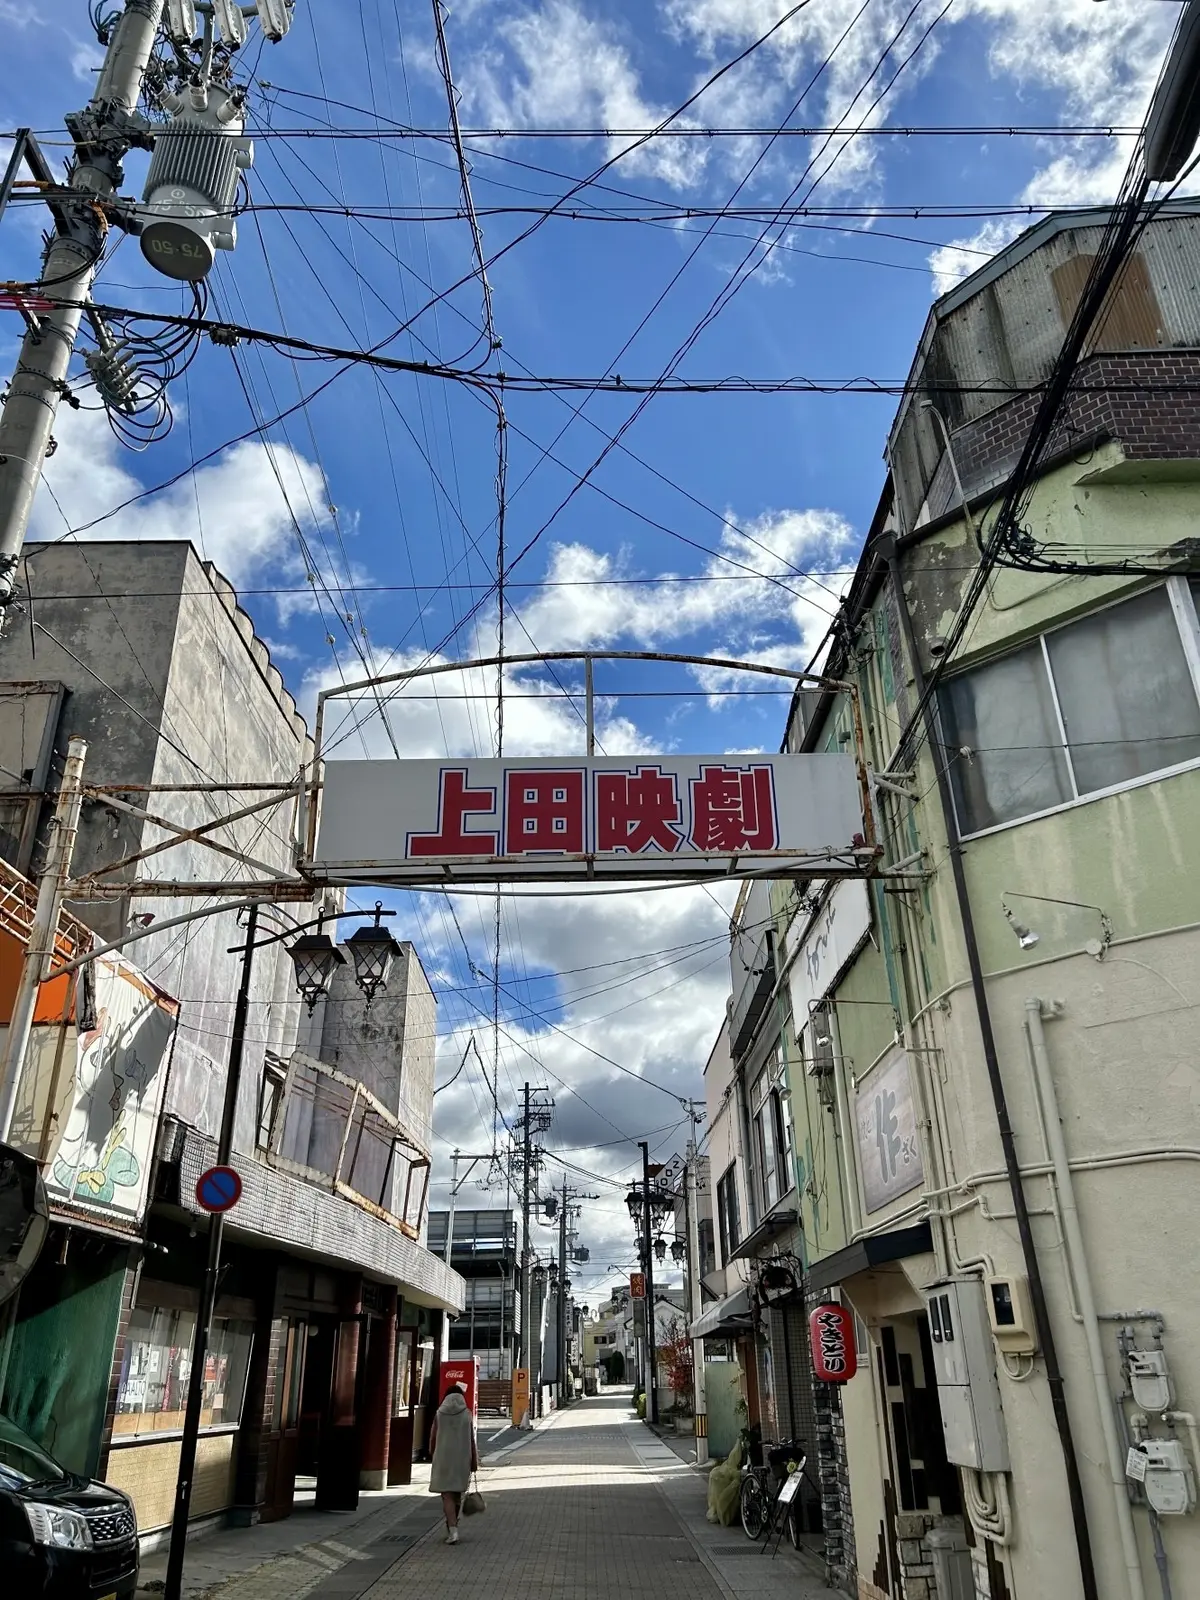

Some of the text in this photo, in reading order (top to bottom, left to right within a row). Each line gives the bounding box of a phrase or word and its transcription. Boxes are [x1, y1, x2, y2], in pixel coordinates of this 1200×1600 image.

[405, 764, 781, 859] 上田映劇
[632, 1274, 643, 1296] 焼肉
[817, 1312, 847, 1374] やきとり
[517, 1372, 526, 1384] P
